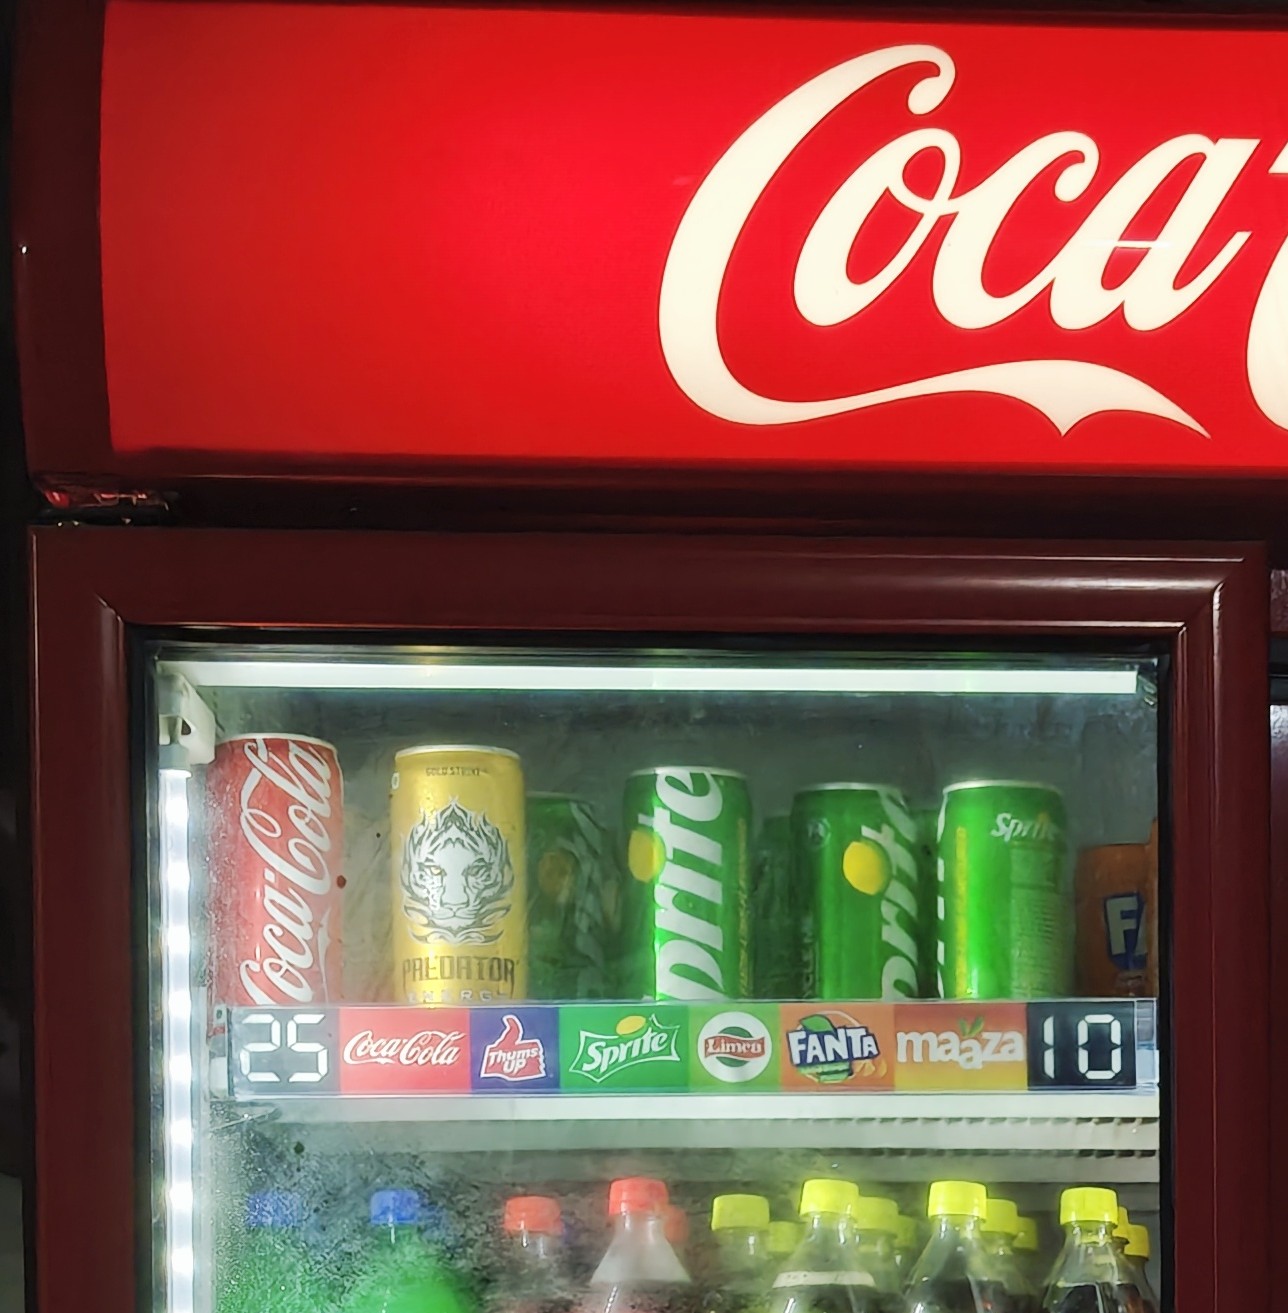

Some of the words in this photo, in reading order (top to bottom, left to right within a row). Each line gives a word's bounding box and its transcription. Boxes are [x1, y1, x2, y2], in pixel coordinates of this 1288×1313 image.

[638, 769, 723, 1003] prite
[241, 1013, 327, 1083] 25
[343, 1030, 461, 1066] Coca-Cola
[584, 1024, 667, 1070] Sprite
[705, 1038, 762, 1056] Limca
[788, 1027, 878, 1063] FANTA
[897, 1029, 1025, 1069] maaza
[1043, 1014, 1122, 1080] 10
